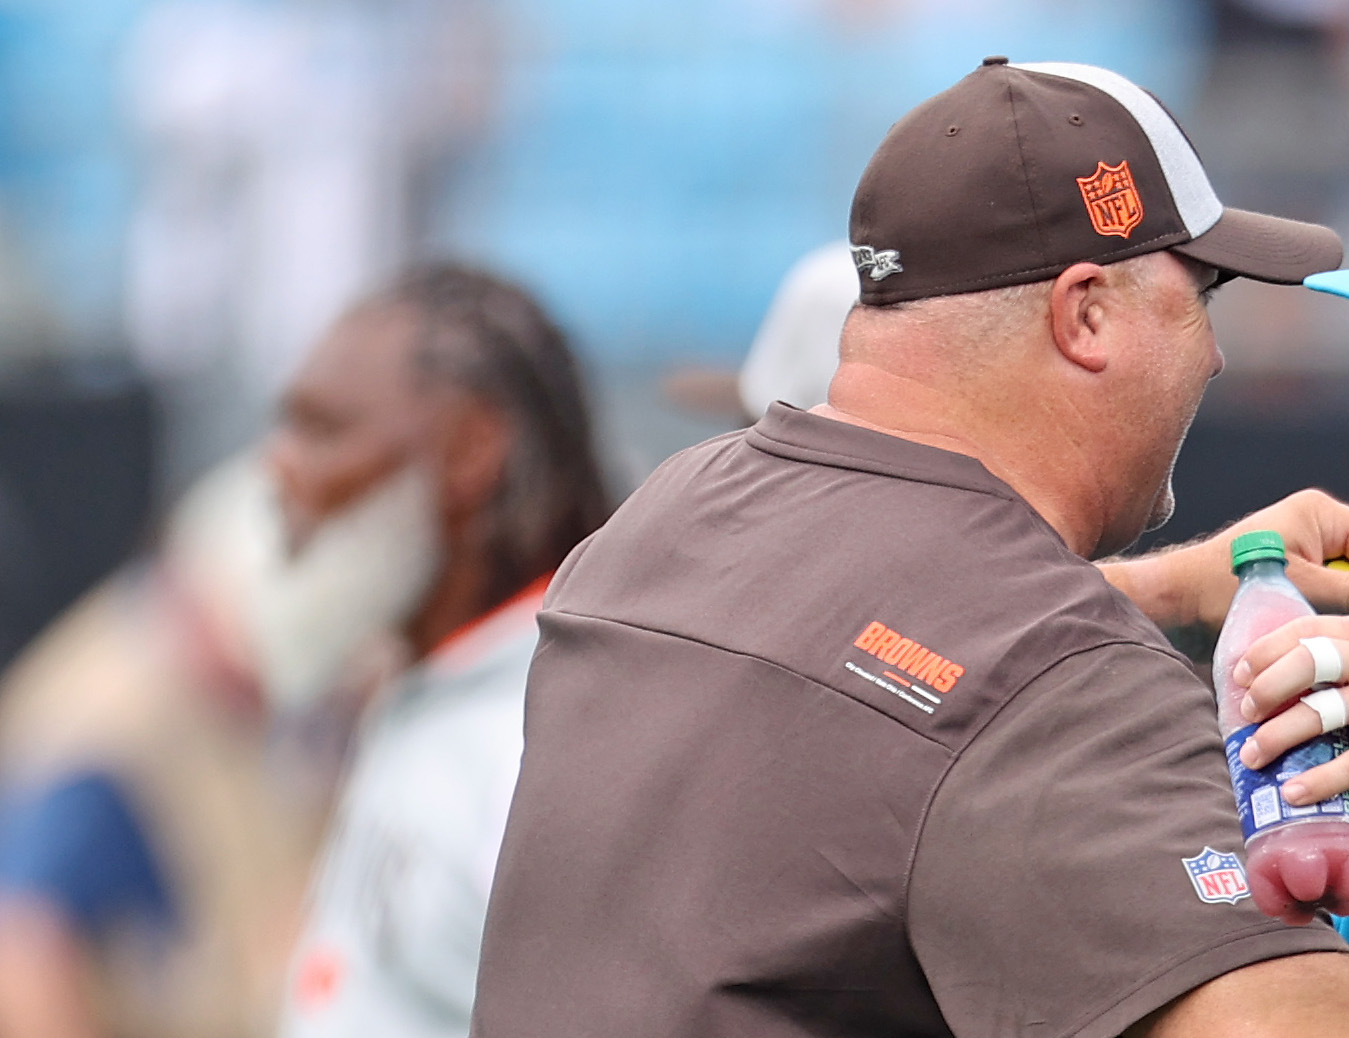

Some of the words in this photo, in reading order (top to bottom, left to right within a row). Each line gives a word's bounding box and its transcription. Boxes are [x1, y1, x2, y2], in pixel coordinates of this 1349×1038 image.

[1092, 194, 1137, 227] NFL
[853, 620, 965, 693] BROWNS
[1200, 870, 1246, 896] NFL
